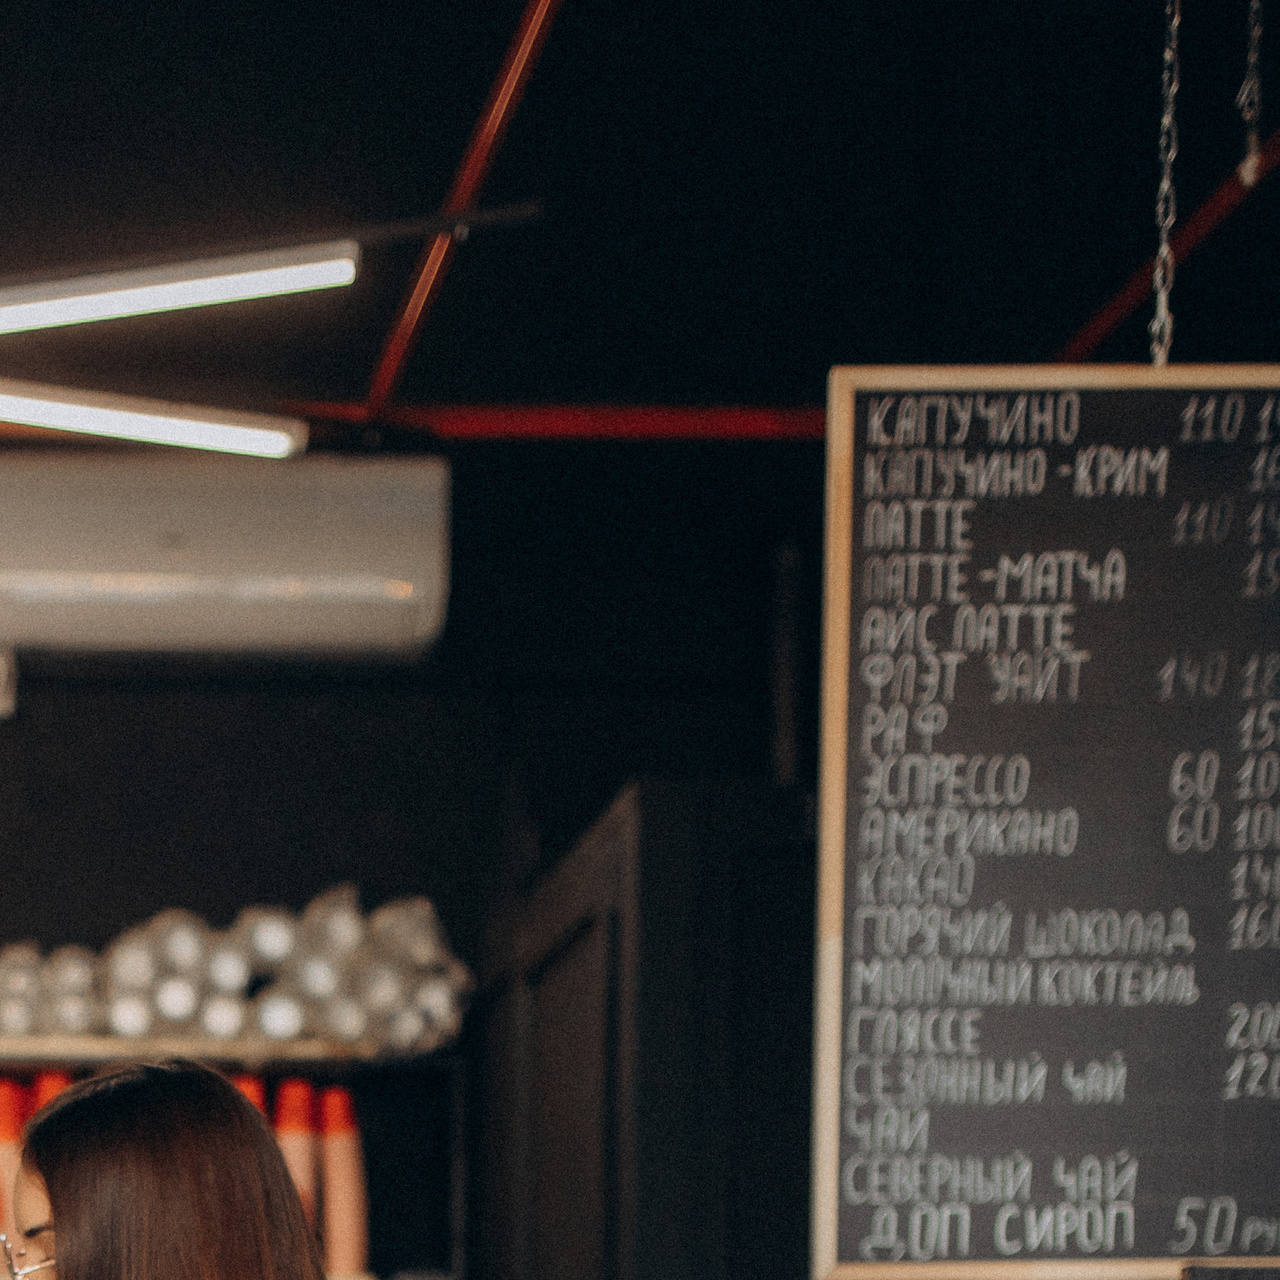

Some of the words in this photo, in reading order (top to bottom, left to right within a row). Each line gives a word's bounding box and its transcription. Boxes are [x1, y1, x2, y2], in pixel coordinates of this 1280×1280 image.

[867, 392, 1080, 445] КАПУЧИНО
[1181, 394, 1245, 442] 110
[863, 500, 975, 550] ЛАТТЕ
[860, 601, 938, 653] АЙС
[952, 602, 1077, 653] ЛАТТЕ
[859, 651, 968, 704] ФЛЭТ
[987, 647, 1091, 704] УАЙТ
[861, 702, 950, 756] РАФ
[861, 752, 1031, 807] ЭСПРЕССО
[1171, 750, 1219, 802] 60
[858, 805, 1079, 857] АМЕРИКАНО
[1167, 801, 1219, 853] 60
[855, 853, 975, 905] КАКАО
[853, 901, 1012, 957] ГОРЯЧИЙ
[1024, 906, 1196, 958] ШОКОЛАД
[846, 1005, 981, 1055] ГЛЯССЕ
[1062, 1051, 1127, 1103] ЧАЙ
[841, 1150, 1033, 1205] СЕВЕРНЫЙ
[1052, 1150, 1139, 1202] ЧАЙ
[859, 1202, 970, 1261] ДОП
[994, 1201, 1135, 1255] СИРОП
